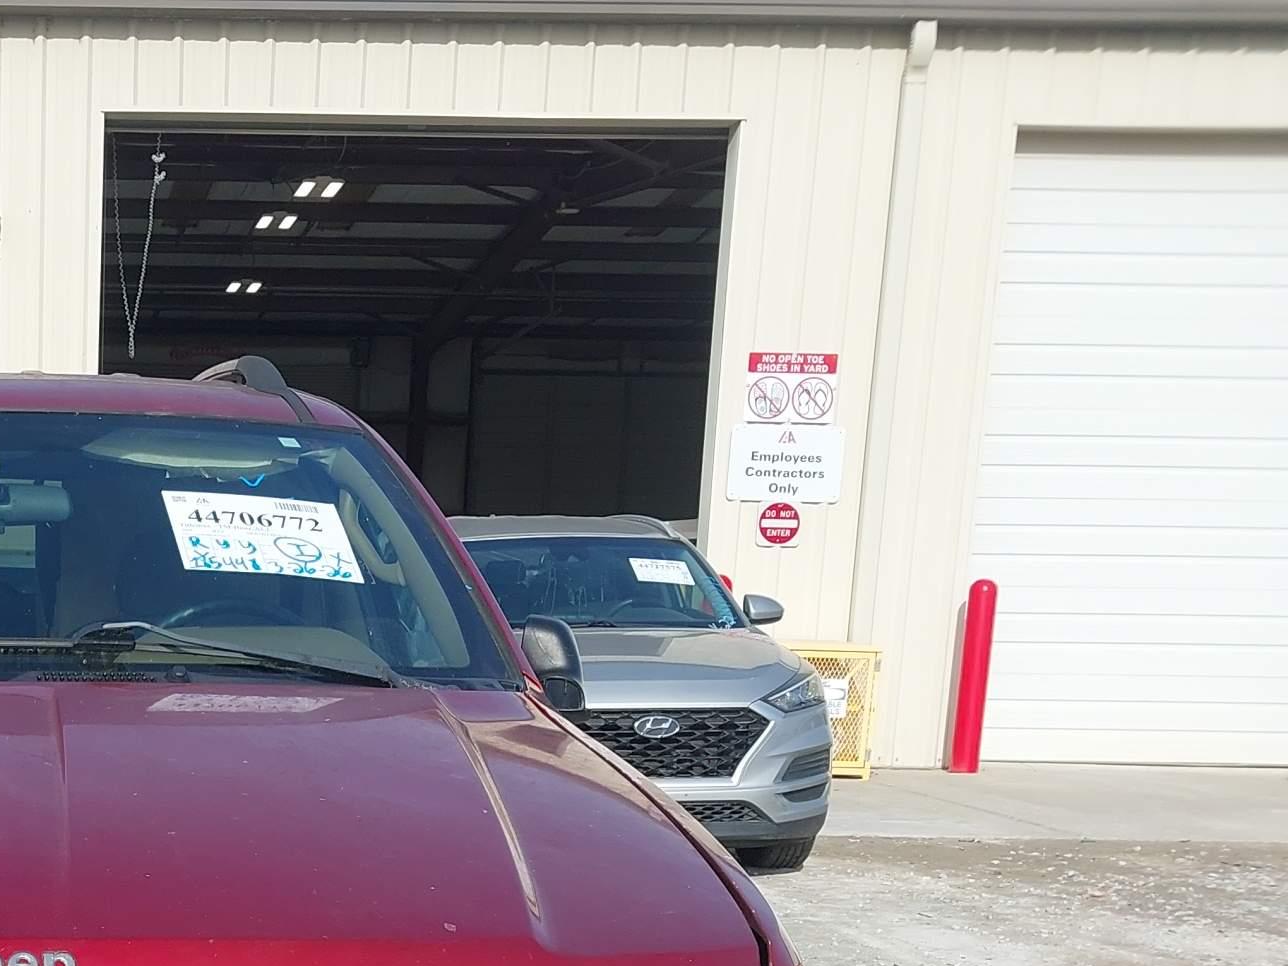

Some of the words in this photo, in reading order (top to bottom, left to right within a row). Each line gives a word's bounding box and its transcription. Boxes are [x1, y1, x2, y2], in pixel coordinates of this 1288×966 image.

[761, 354, 777, 363] NO
[778, 354, 805, 364] OPEN
[806, 355, 825, 364] TOE
[756, 363, 789, 372] SHOES
[790, 364, 801, 373] IN
[802, 364, 830, 373] YARD
[751, 450, 823, 465] Employees
[745, 466, 825, 479] Contractors
[768, 482, 799, 497] Only
[765, 509, 777, 518] DO
[779, 510, 795, 518] NOT
[187, 508, 324, 533] 44706772
[766, 528, 792, 537] ENTER
